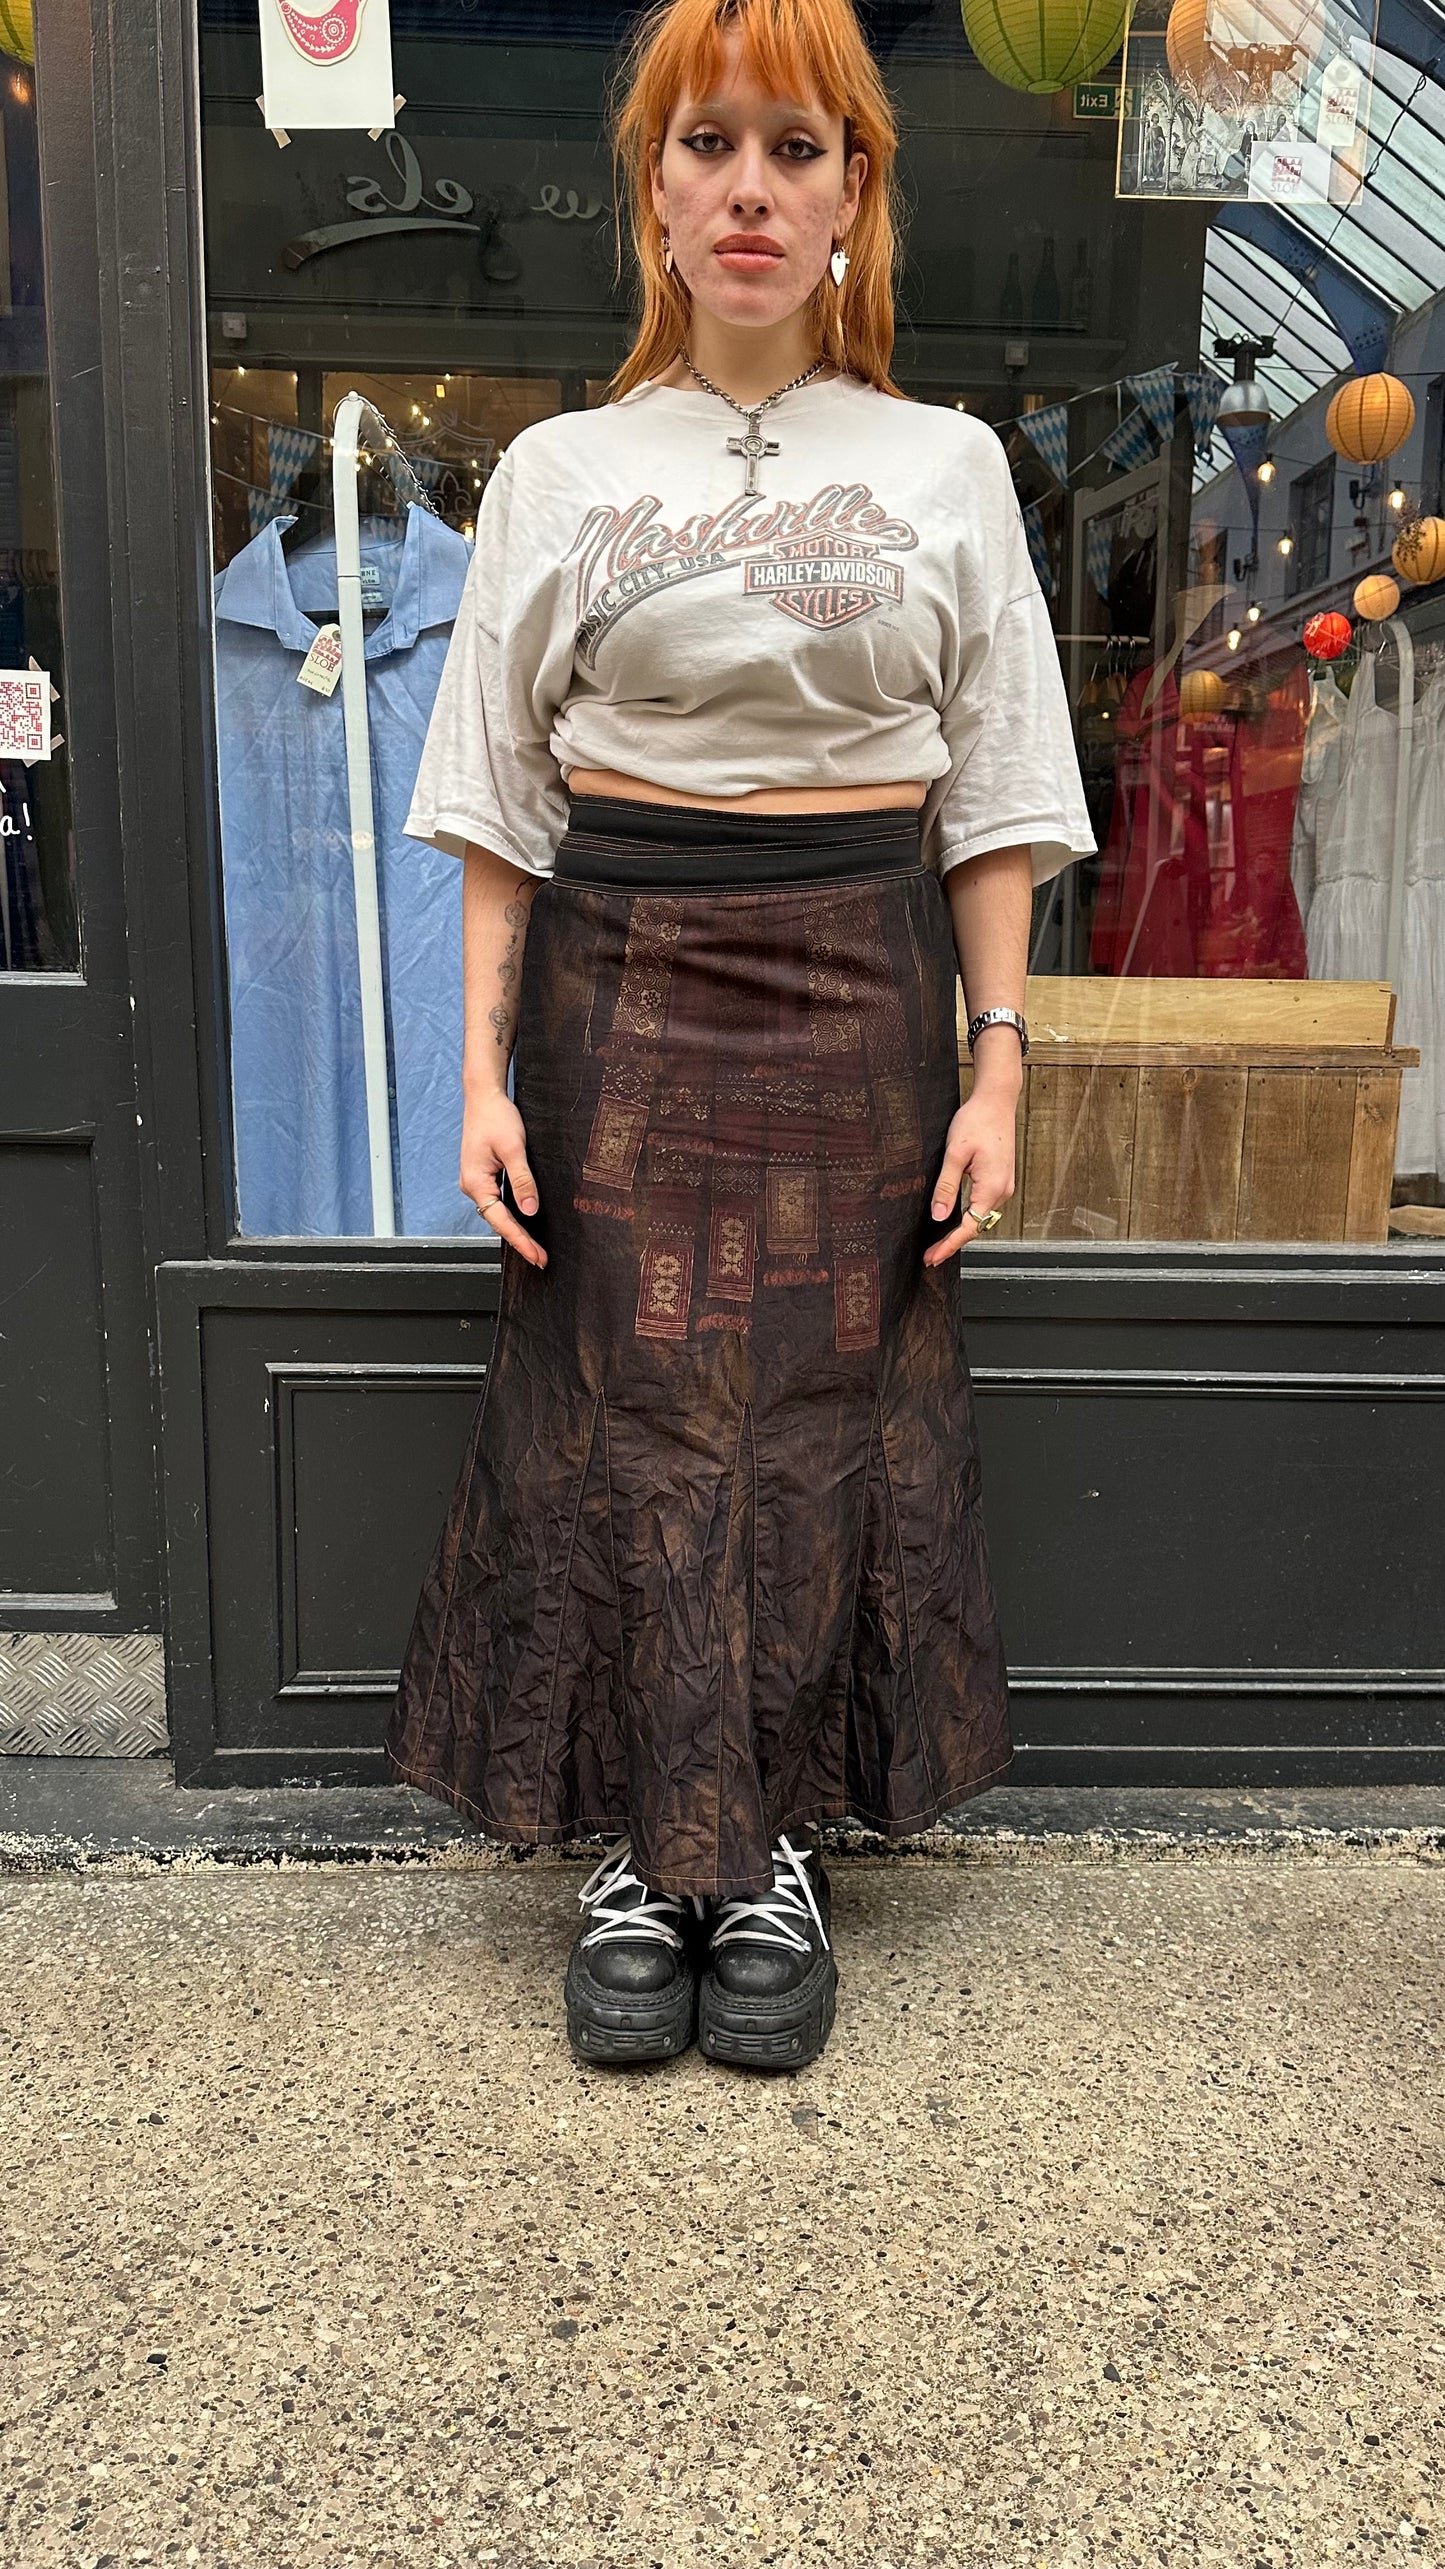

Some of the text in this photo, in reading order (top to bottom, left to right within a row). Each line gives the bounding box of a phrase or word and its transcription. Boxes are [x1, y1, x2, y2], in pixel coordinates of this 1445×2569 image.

[561, 483, 919, 608] Nashville
[679, 552, 726, 571] USA
[789, 536, 865, 558] MOTOR
[753, 560, 896, 592] HARLEY-DAVIDSON
[786, 587, 864, 623] CYCLES
